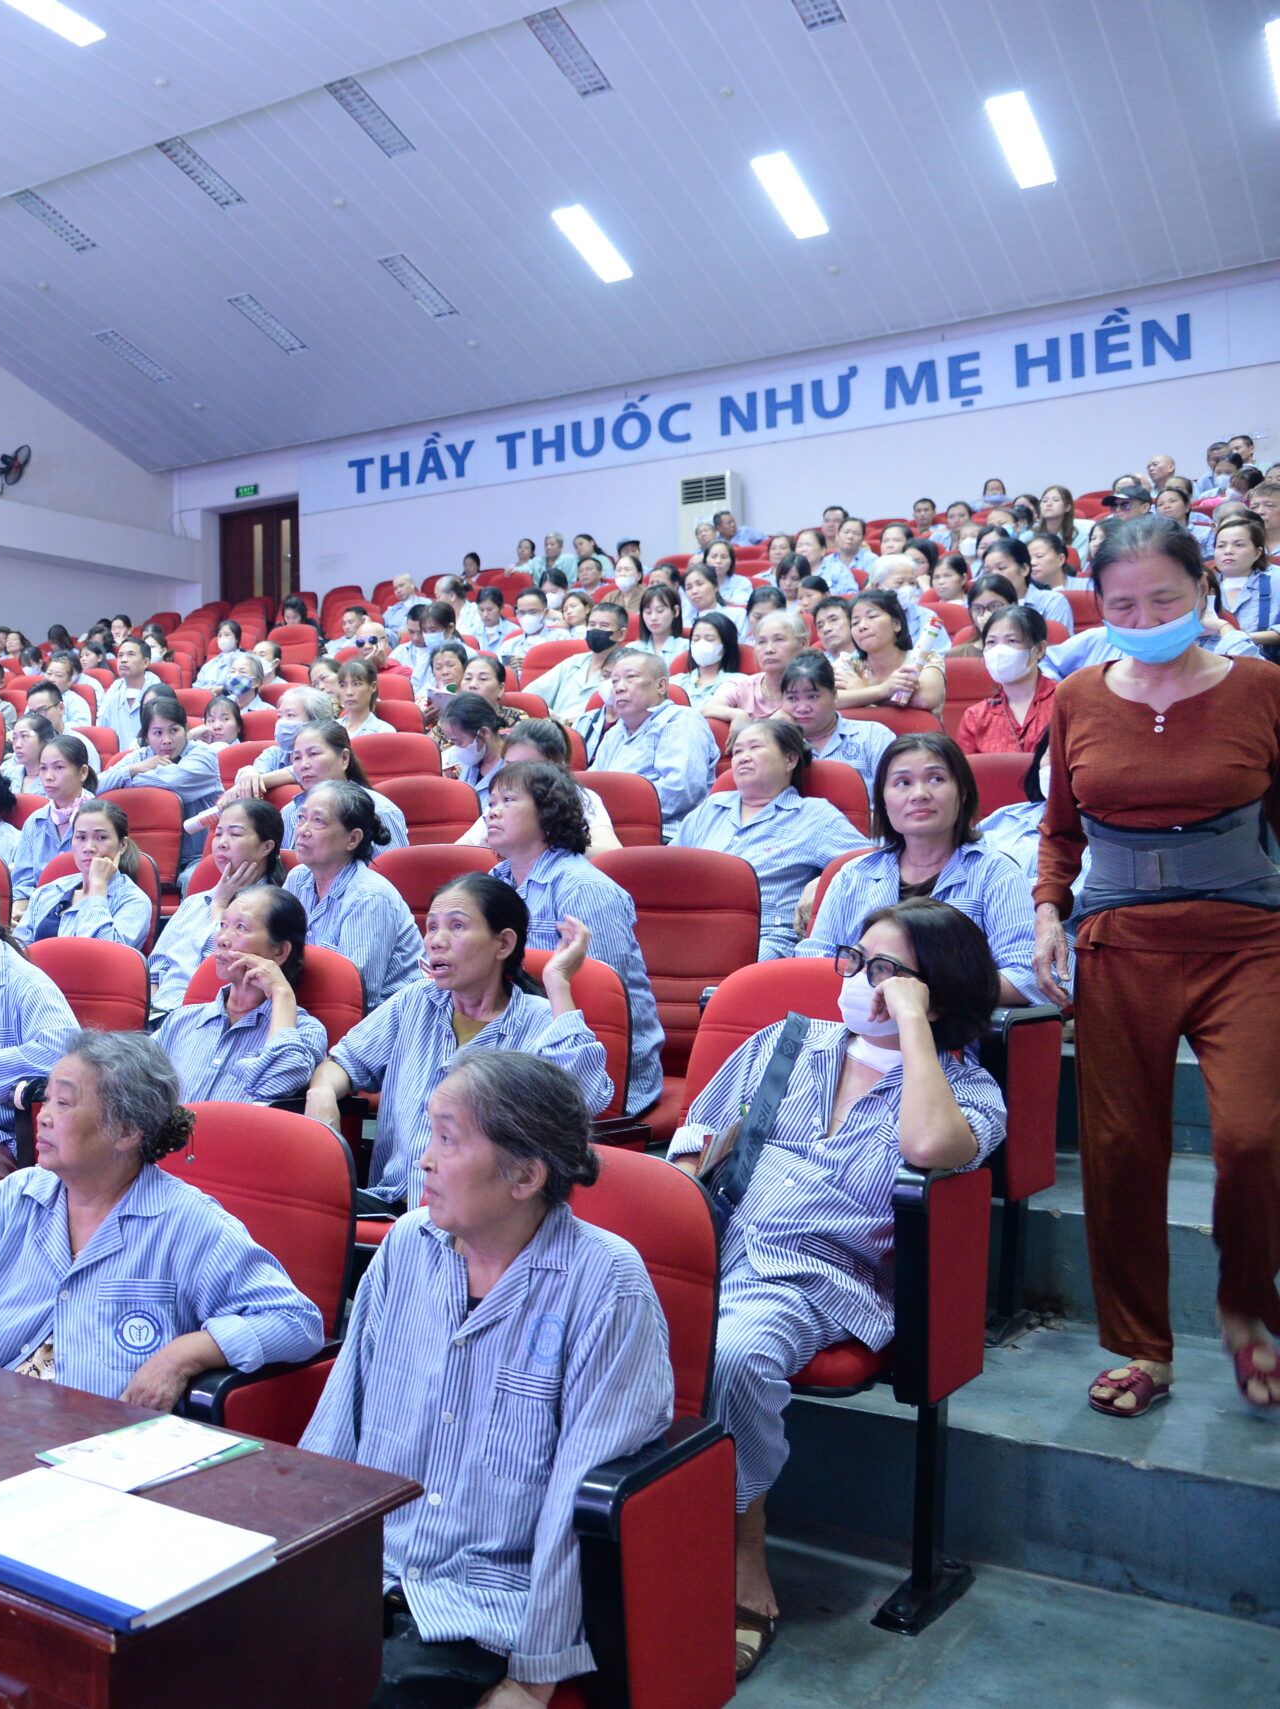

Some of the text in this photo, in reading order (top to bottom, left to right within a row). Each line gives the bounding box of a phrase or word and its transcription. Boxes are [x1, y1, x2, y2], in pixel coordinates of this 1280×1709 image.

[348, 307, 1192, 494] THẦY THUỐC NHƯ MẸ HIỀN
